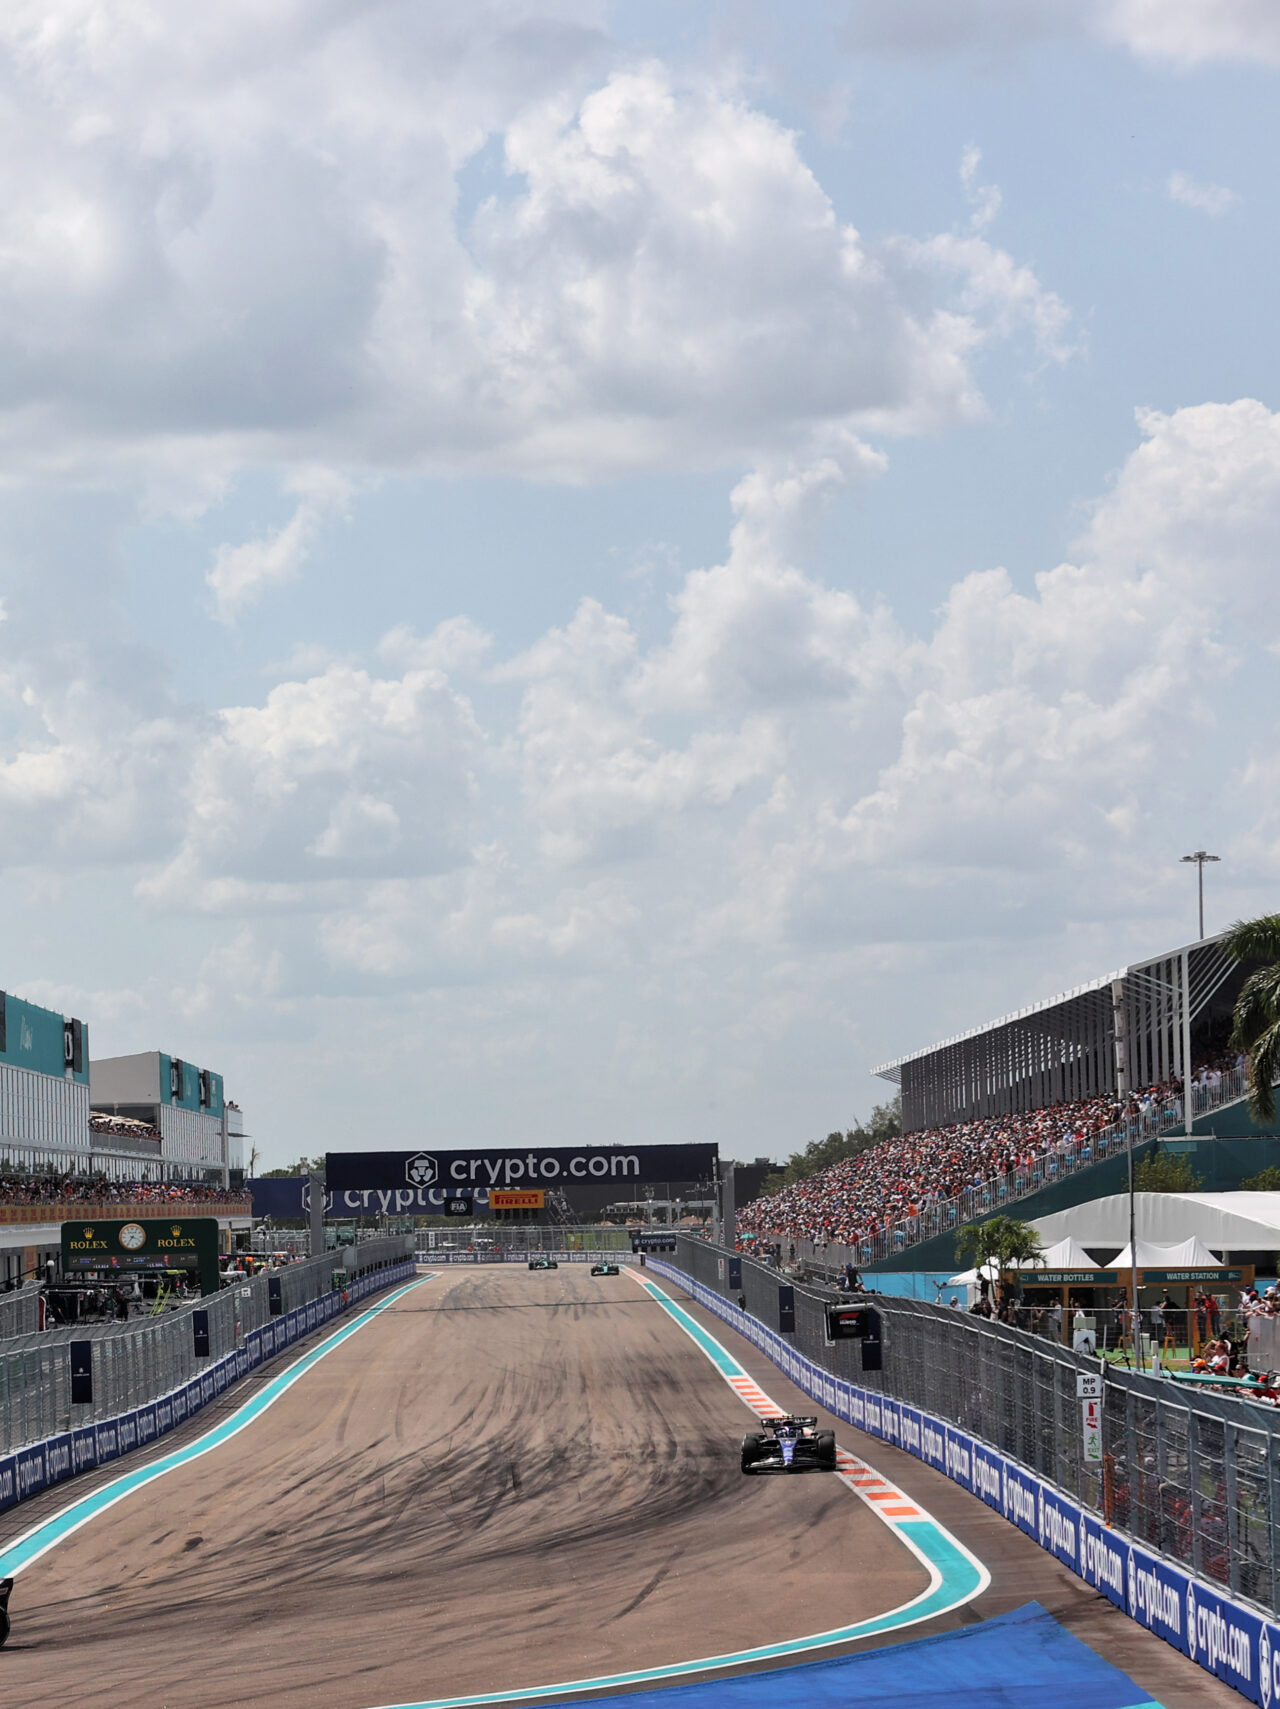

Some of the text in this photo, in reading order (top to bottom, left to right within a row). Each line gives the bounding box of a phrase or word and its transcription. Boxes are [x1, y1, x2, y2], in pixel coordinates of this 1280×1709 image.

[450, 1153, 640, 1184] crypto.com
[494, 1193, 539, 1205] PIRELLI
[451, 1202, 466, 1211] FIA
[70, 1240, 108, 1249] ROLEX
[157, 1238, 195, 1248] ROLEX
[641, 1237, 675, 1247] crypto.com
[1037, 1273, 1094, 1282] WATER BOTTLES
[1166, 1272, 1219, 1280] WATER STATION
[1083, 1378, 1096, 1386] MP
[1008, 1476, 1035, 1528] crypto.com
[1045, 1503, 1076, 1559] crypto.com
[1087, 1534, 1123, 1596] crypto.com
[1137, 1567, 1181, 1635] crypto.com
[1197, 1605, 1252, 1681] crypto.com
